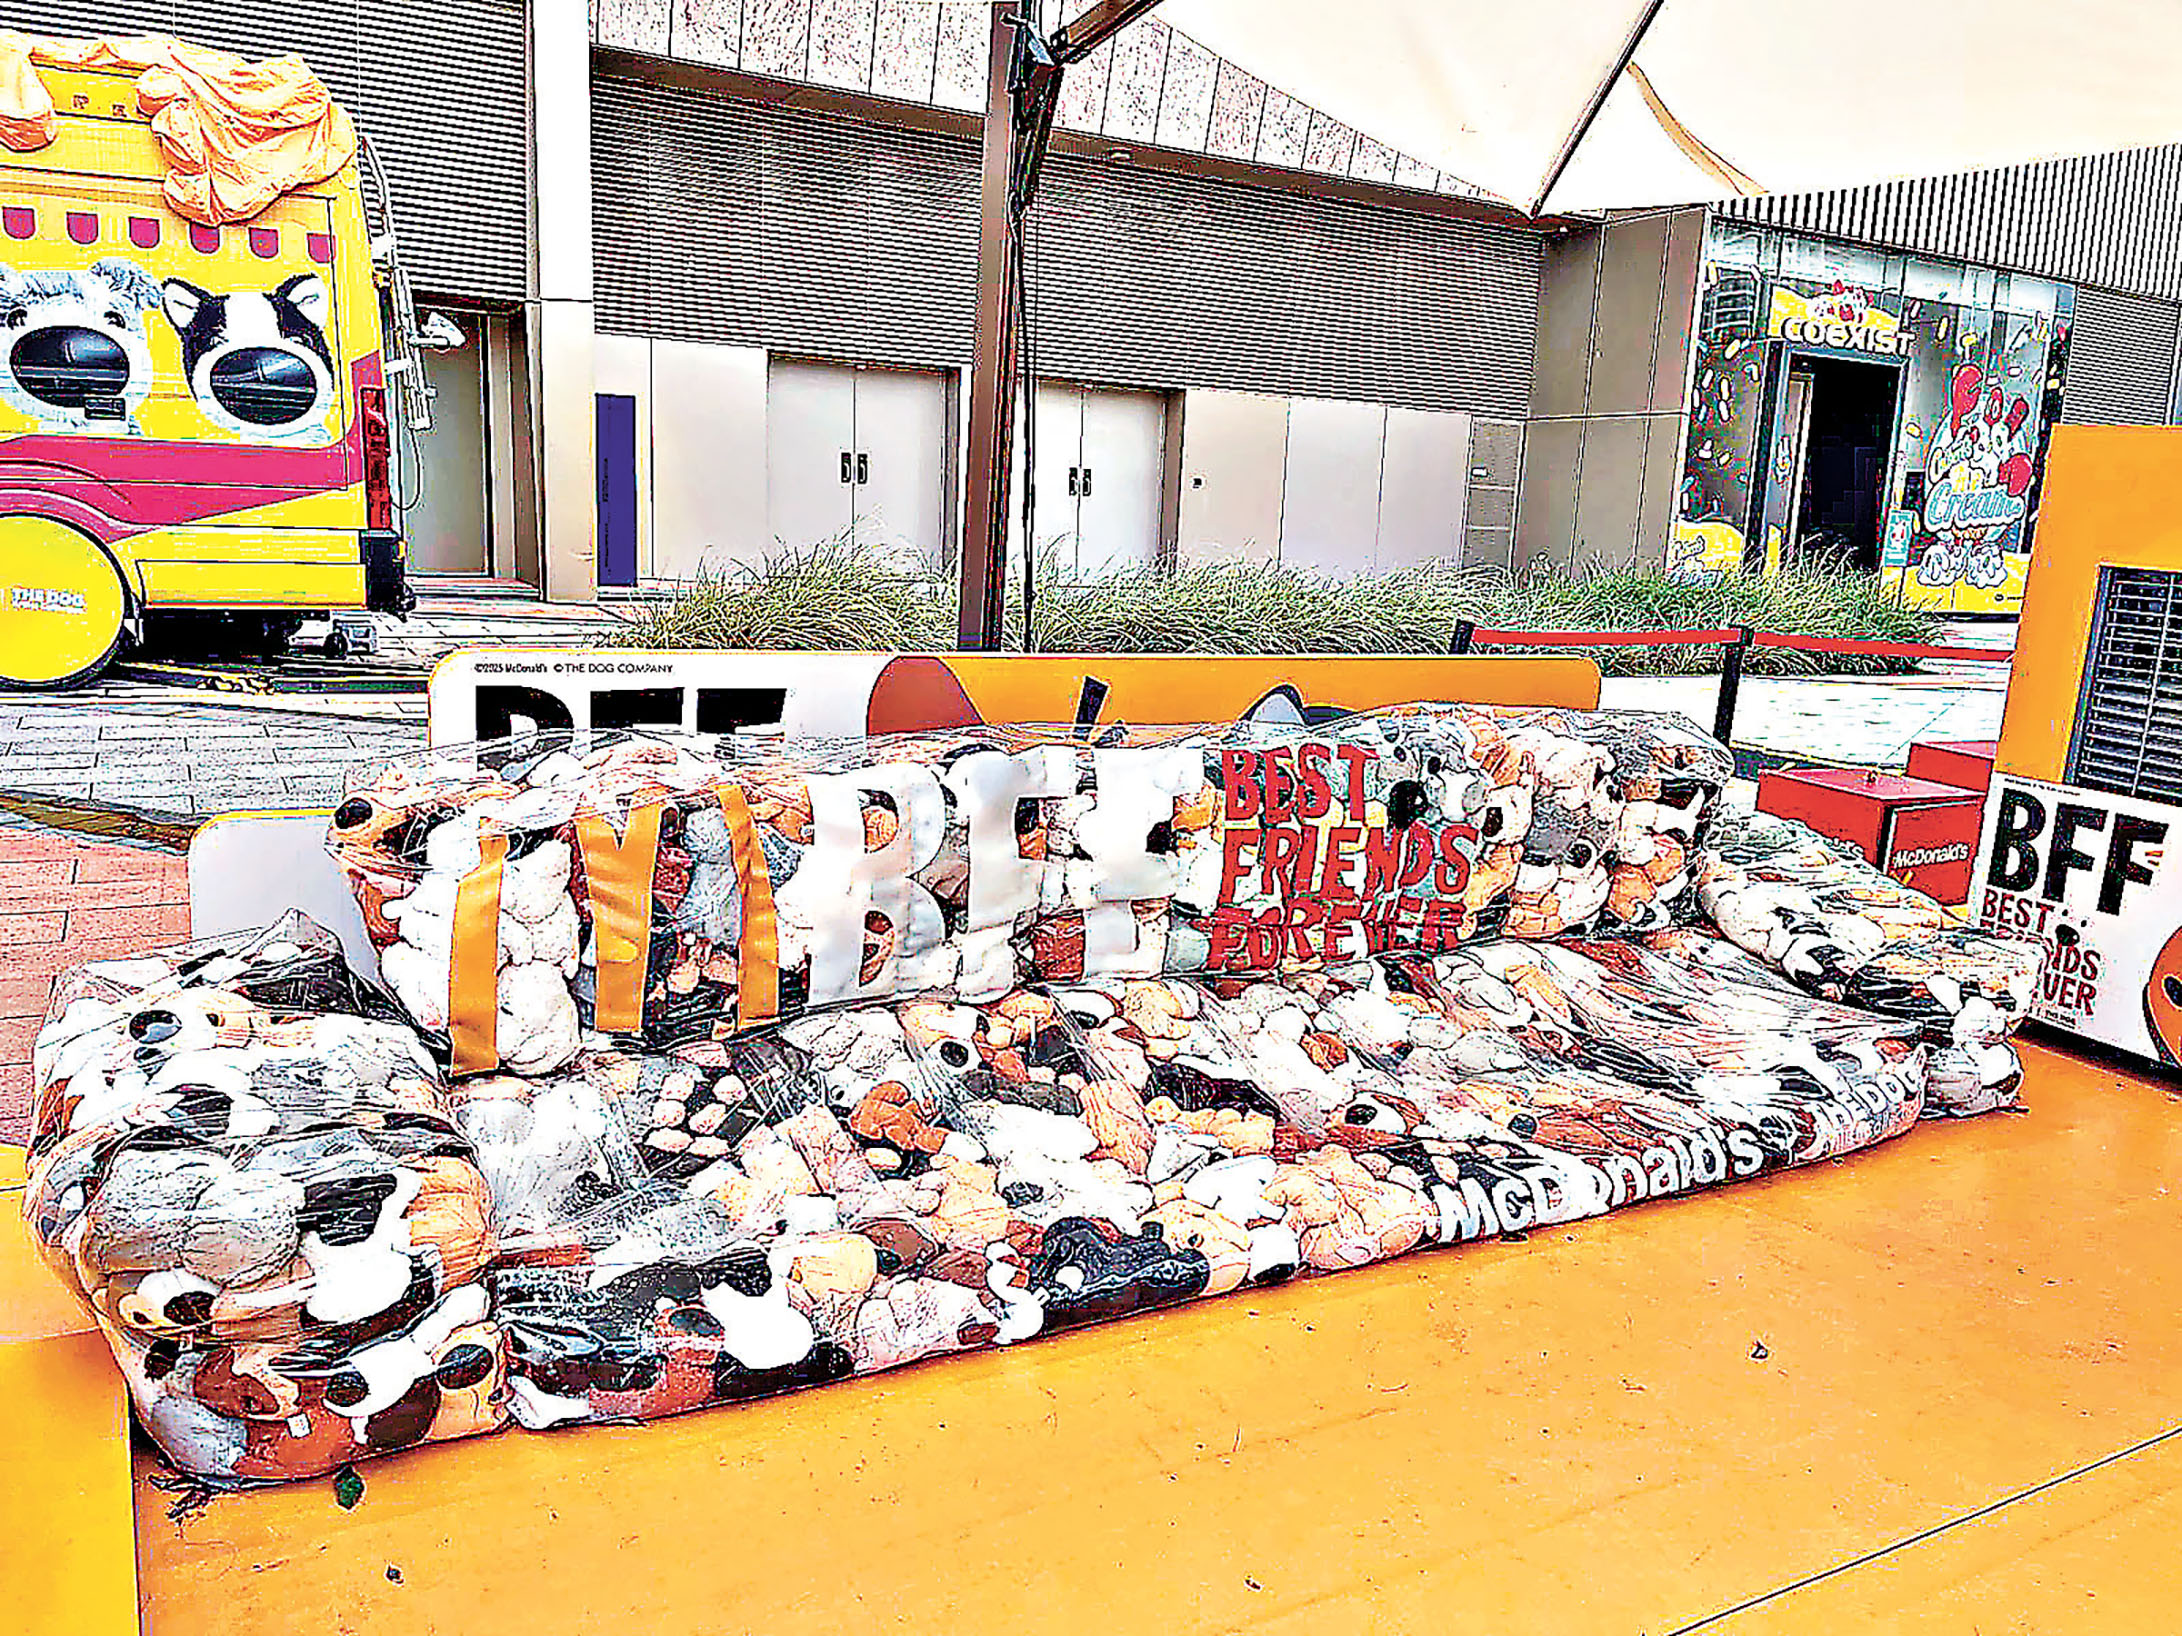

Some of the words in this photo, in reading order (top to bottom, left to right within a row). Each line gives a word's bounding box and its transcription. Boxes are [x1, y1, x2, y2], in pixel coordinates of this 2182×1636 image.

[1782, 318, 1916, 356] COEXIST
[588, 663, 614, 673] DOG
[617, 663, 673, 673] COMPANY
[1221, 743, 1379, 823] BEST
[803, 744, 1204, 1009] BFF
[1216, 822, 1478, 906] FRIENDS
[1892, 841, 1970, 869] McDonald's
[1987, 788, 2169, 916] BFF
[1207, 895, 1465, 971] FOREVER
[1981, 888, 2055, 934] BEST
[1437, 1122, 1764, 1243] McDonald's
